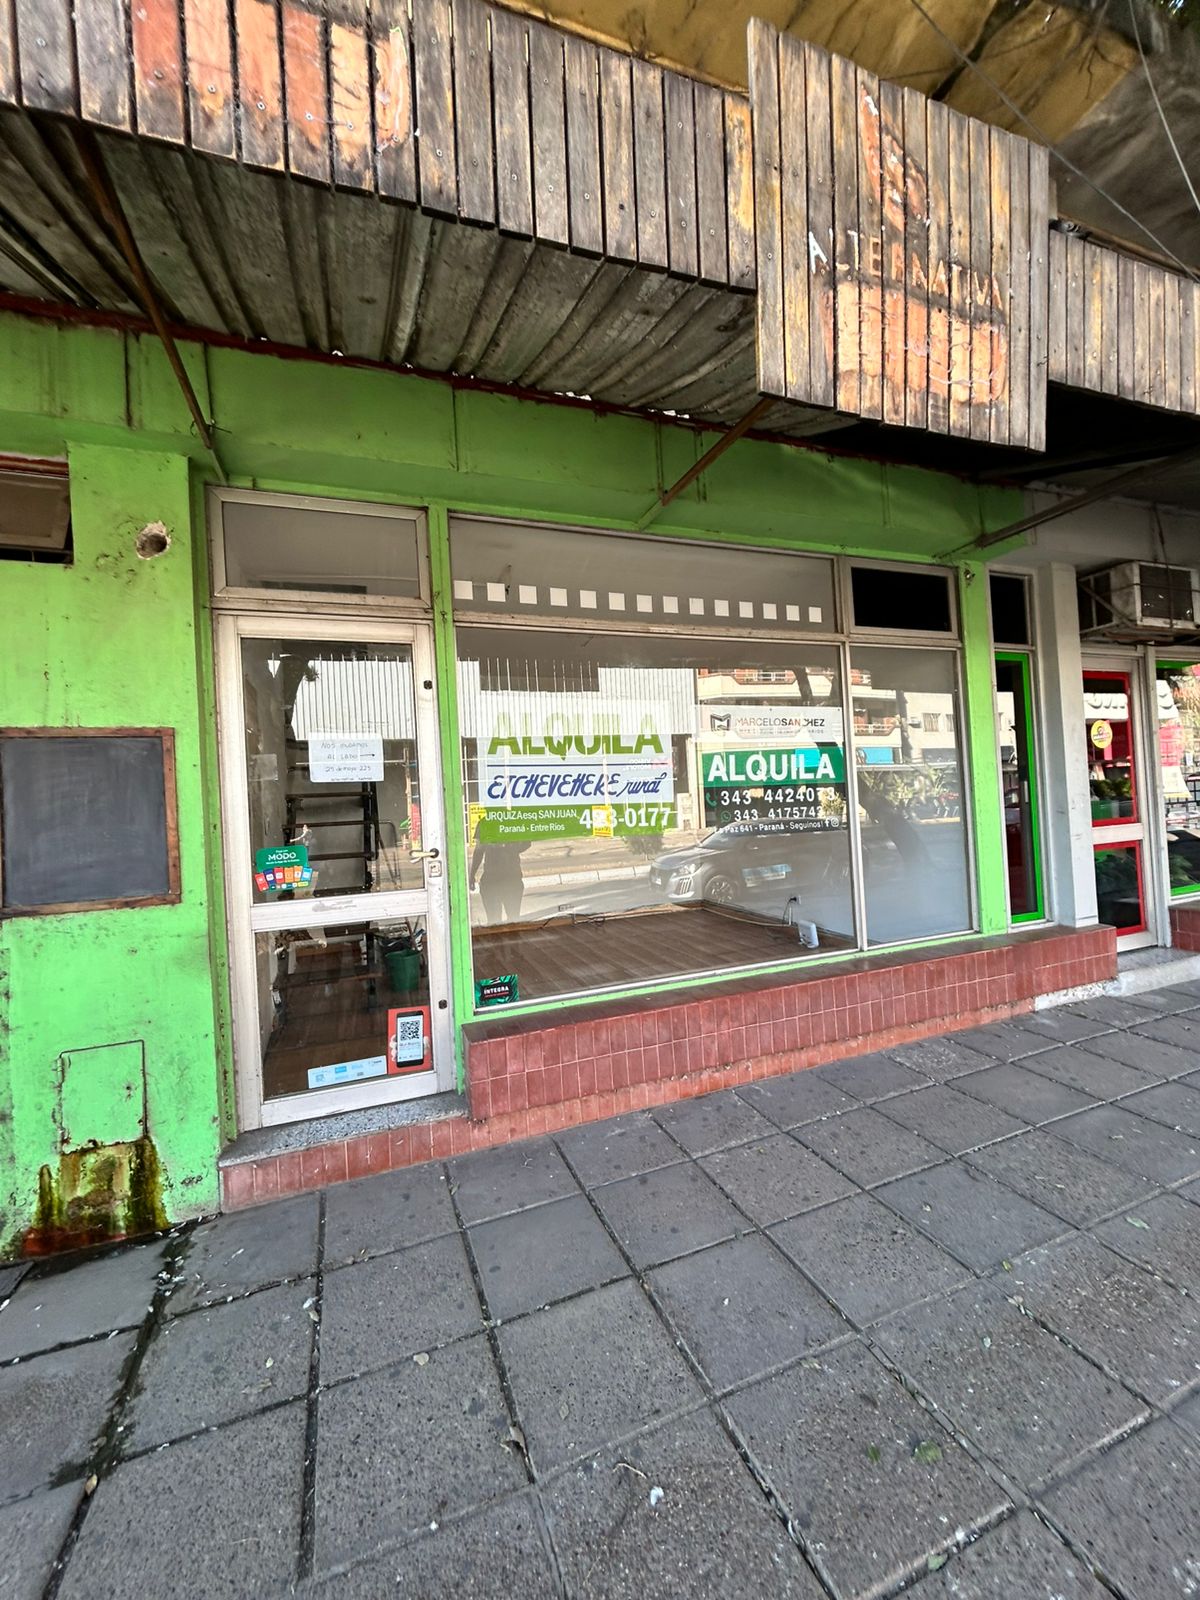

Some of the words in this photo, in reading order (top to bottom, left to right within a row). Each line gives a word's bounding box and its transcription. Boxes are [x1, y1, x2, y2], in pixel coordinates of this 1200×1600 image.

[487, 711, 664, 761] ALQUILA
[707, 753, 836, 782] ALQUILA
[720, 790, 752, 806] 343
[734, 809, 759, 822] 343
[499, 823, 526, 833] Paraná
[739, 824, 753, 832] 641
[759, 822, 785, 832] Paraná
[268, 852, 296, 861] MODO
